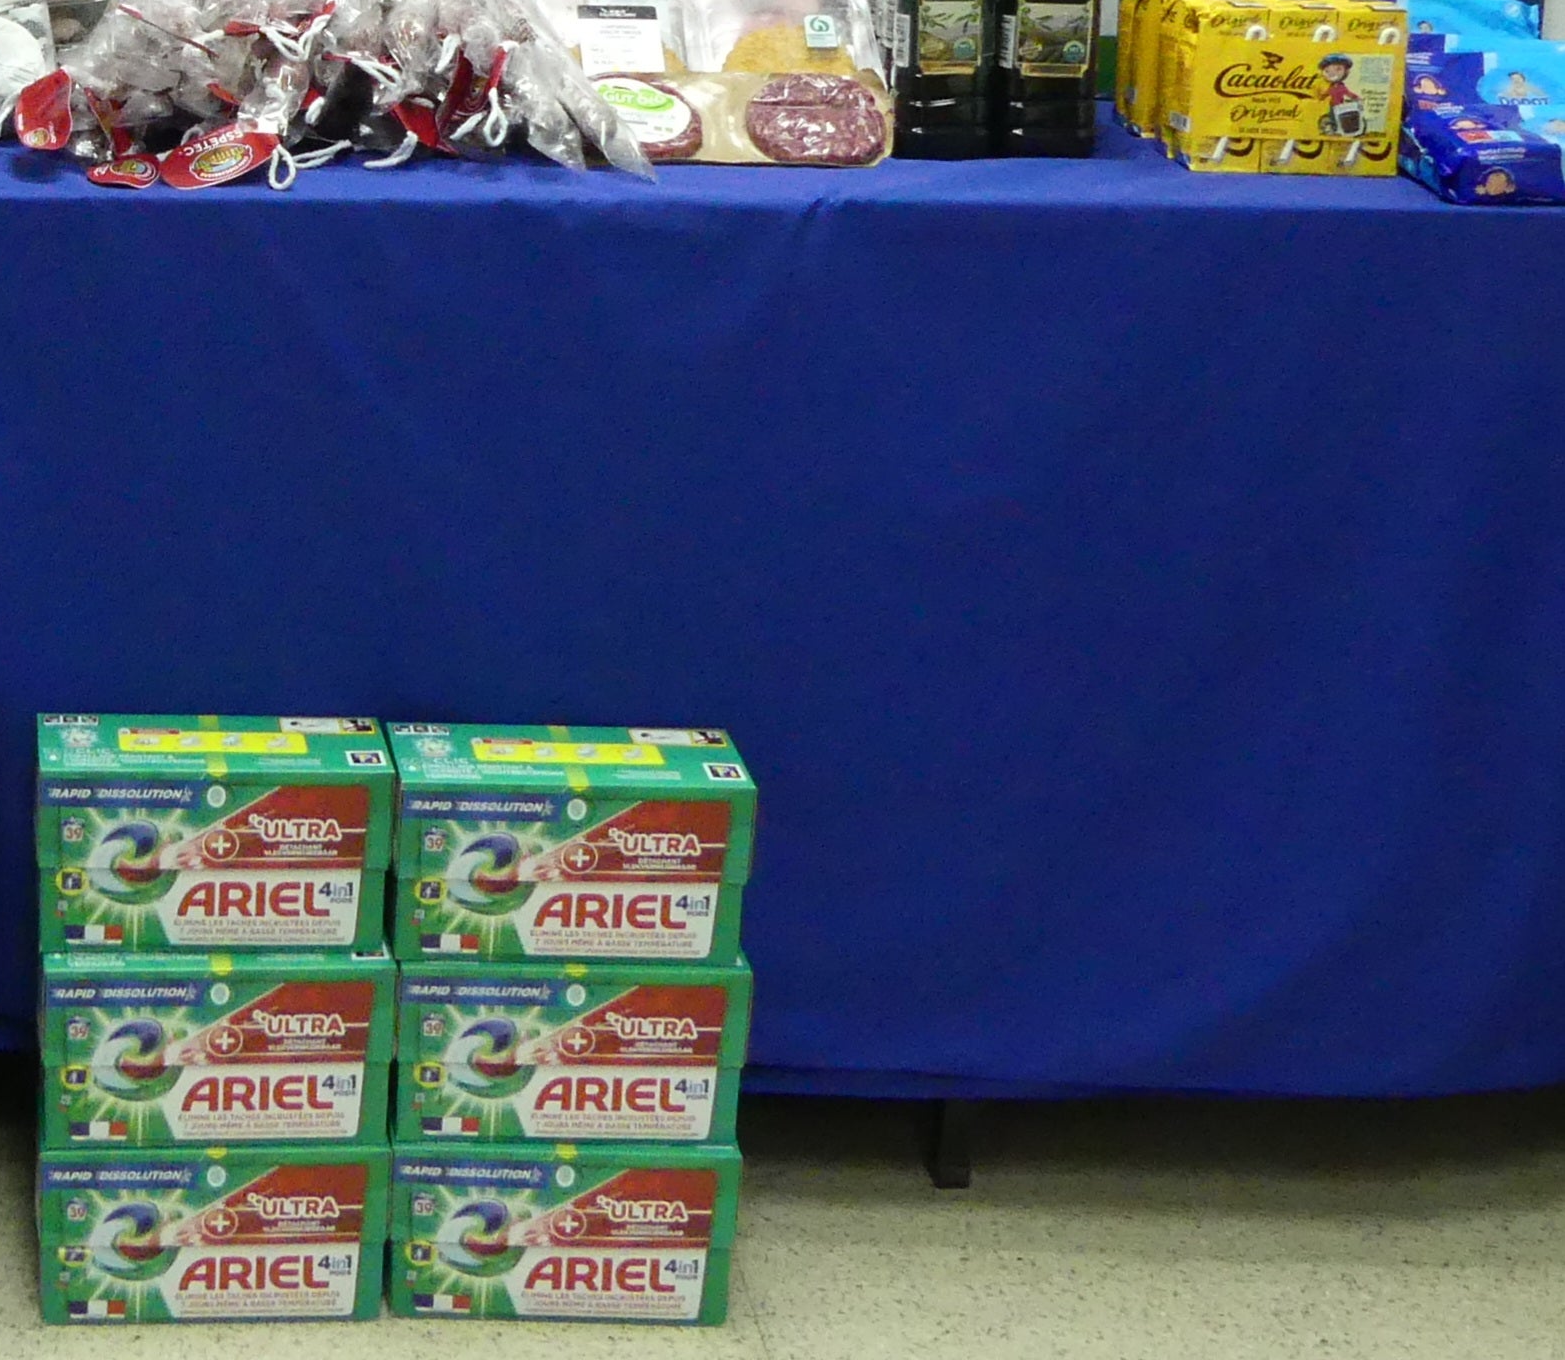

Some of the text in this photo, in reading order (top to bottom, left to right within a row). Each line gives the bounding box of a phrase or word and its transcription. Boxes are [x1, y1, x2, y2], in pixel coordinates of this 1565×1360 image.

[1214, 63, 1319, 98] Cacaolat
[1230, 104, 1301, 123] Original
[49, 787, 183, 800] RAPID DISSOLUTION
[410, 800, 543, 812] RAPID DISSOLUTION
[66, 827, 83, 840] 39
[263, 820, 341, 840] ULTRA
[621, 835, 701, 856] ULTRA
[176, 881, 354, 917] ARIEL 4in1
[533, 892, 711, 930] ARIEL 4in1
[55, 987, 186, 1000] RAPID DISSOLUTION
[411, 984, 540, 998] RAPID DISSOLUTION
[266, 1015, 345, 1036] ULTRA
[619, 1019, 696, 1038] ULTRA
[181, 1074, 357, 1112] ARIEL 4in1
[534, 1076, 710, 1113] ARIEL 4in1
[51, 1169, 182, 1181] RAPID DISSOLUTION
[401, 1166, 532, 1180] RAPID DISSOLUTION
[262, 1198, 339, 1218] ULTRA
[610, 1202, 688, 1222] ULTRA
[178, 1254, 352, 1291] ARIEL 4in1
[524, 1256, 699, 1293] ARIEL 4in1
